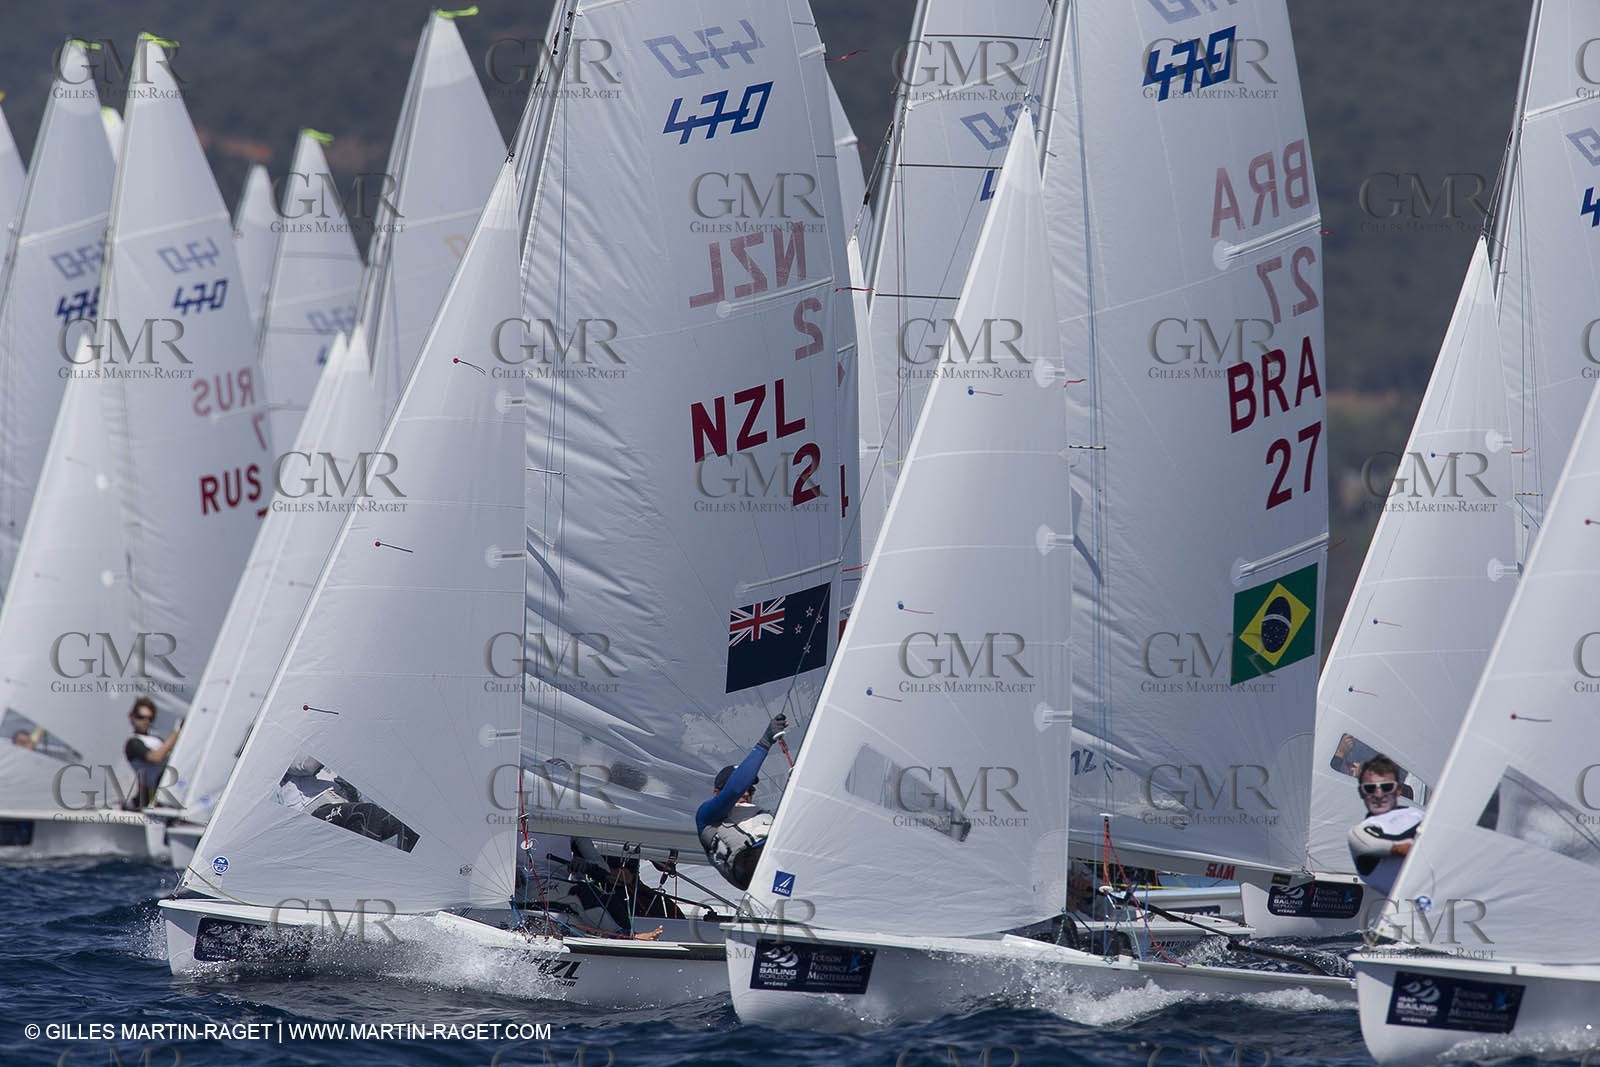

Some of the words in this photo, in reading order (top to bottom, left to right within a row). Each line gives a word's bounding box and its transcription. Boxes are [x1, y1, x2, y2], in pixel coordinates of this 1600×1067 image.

[1143, 25, 1237, 102] 470
[663, 81, 774, 145] 470
[173, 278, 229, 316] 470
[1228, 336, 1322, 434] BRA
[690, 378, 806, 463] NZL
[199, 463, 262, 515] RUS
[792, 442, 822, 506] 2
[1265, 420, 1322, 510] 27
[759, 967, 797, 976] SAILING
